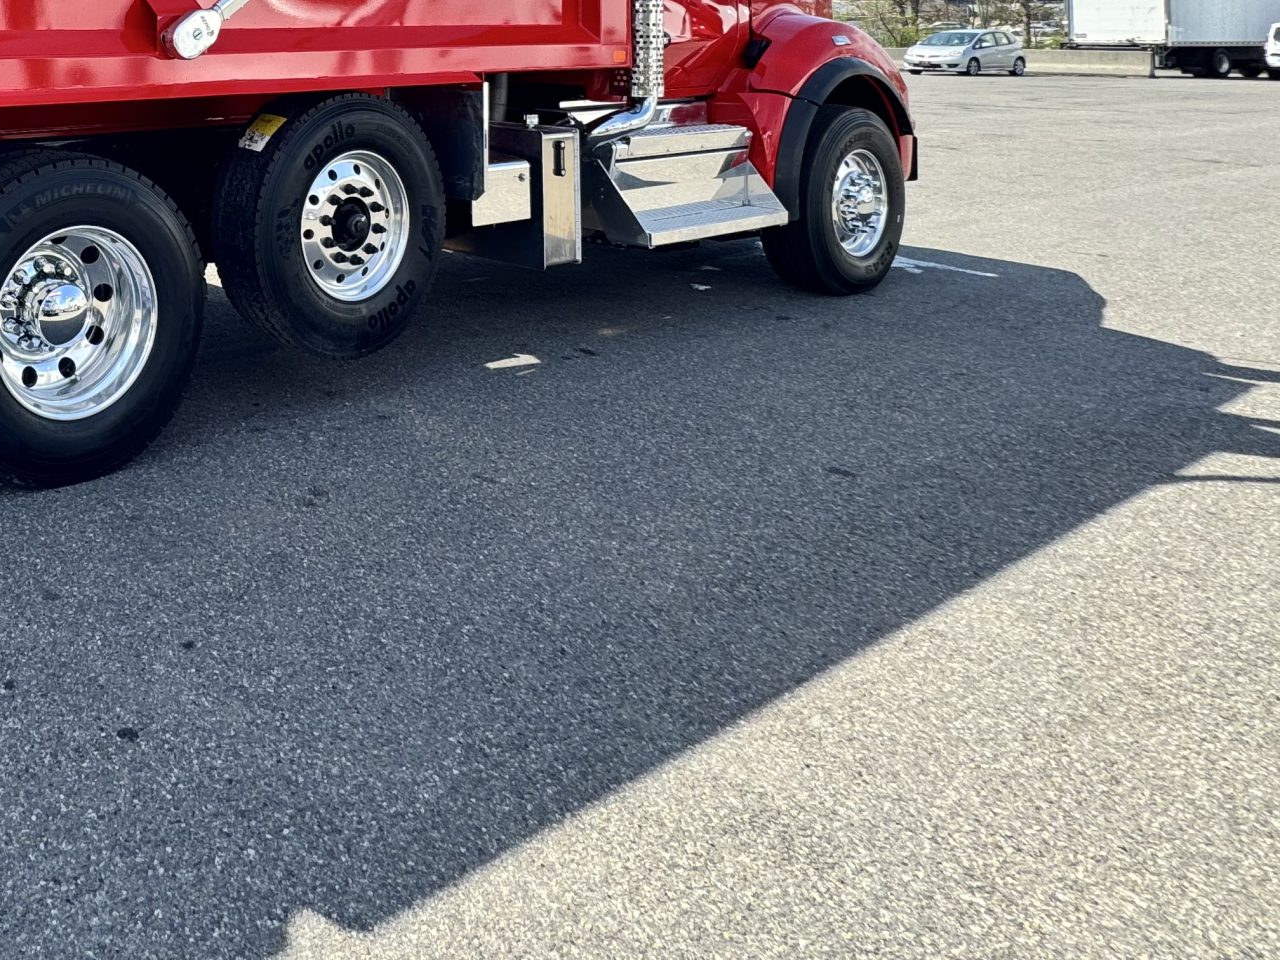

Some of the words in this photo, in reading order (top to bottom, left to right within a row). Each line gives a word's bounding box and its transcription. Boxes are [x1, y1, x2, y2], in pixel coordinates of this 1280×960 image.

[303, 121, 355, 171] apollo
[35, 183, 125, 208] MICHELIN
[368, 279, 416, 332] apollo
